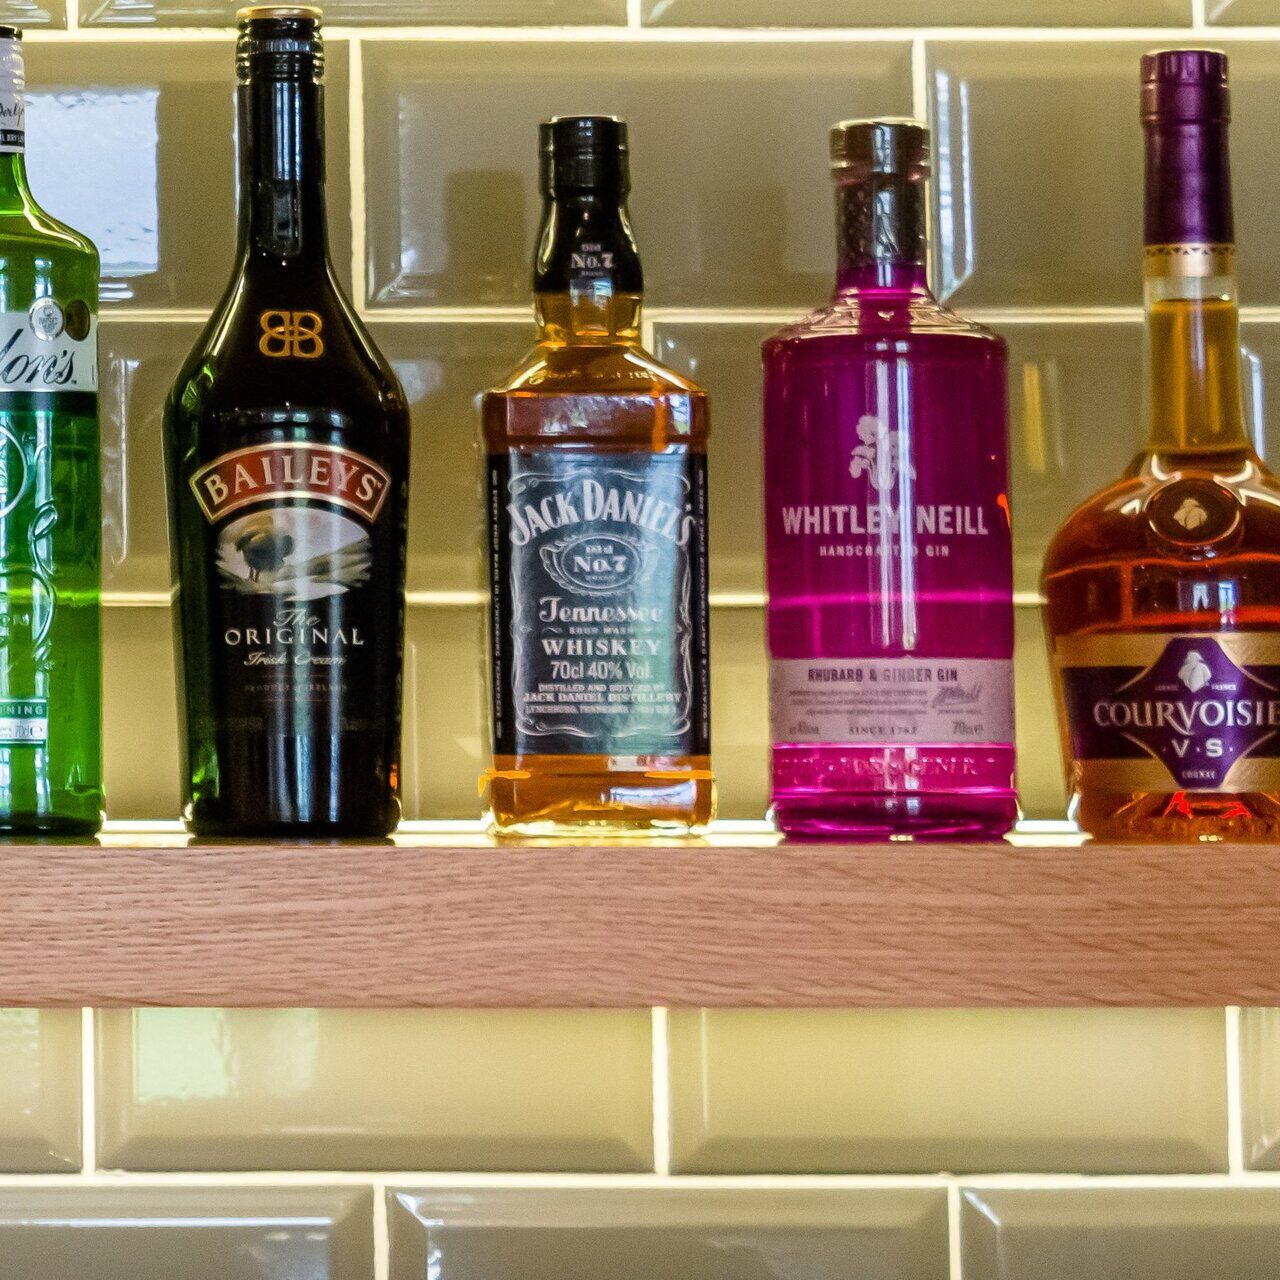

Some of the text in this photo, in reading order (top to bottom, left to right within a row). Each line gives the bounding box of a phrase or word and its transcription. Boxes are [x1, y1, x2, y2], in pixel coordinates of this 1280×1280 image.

[204, 455, 377, 506] BAILEYS
[506, 479, 696, 546] JACK DANIEL'S
[782, 505, 989, 536] WHITLEY NEILL
[819, 545, 950, 557] HANDCRATD GIN
[273, 609, 321, 626] The
[539, 596, 664, 622] Tennessee
[225, 628, 364, 646] ORIGINAL
[541, 639, 661, 656] WHISKEY
[550, 661, 584, 680] 70cl
[588, 661, 623, 680] 40%
[807, 669, 863, 682] RHUBARB
[937, 669, 958, 681] GIN
